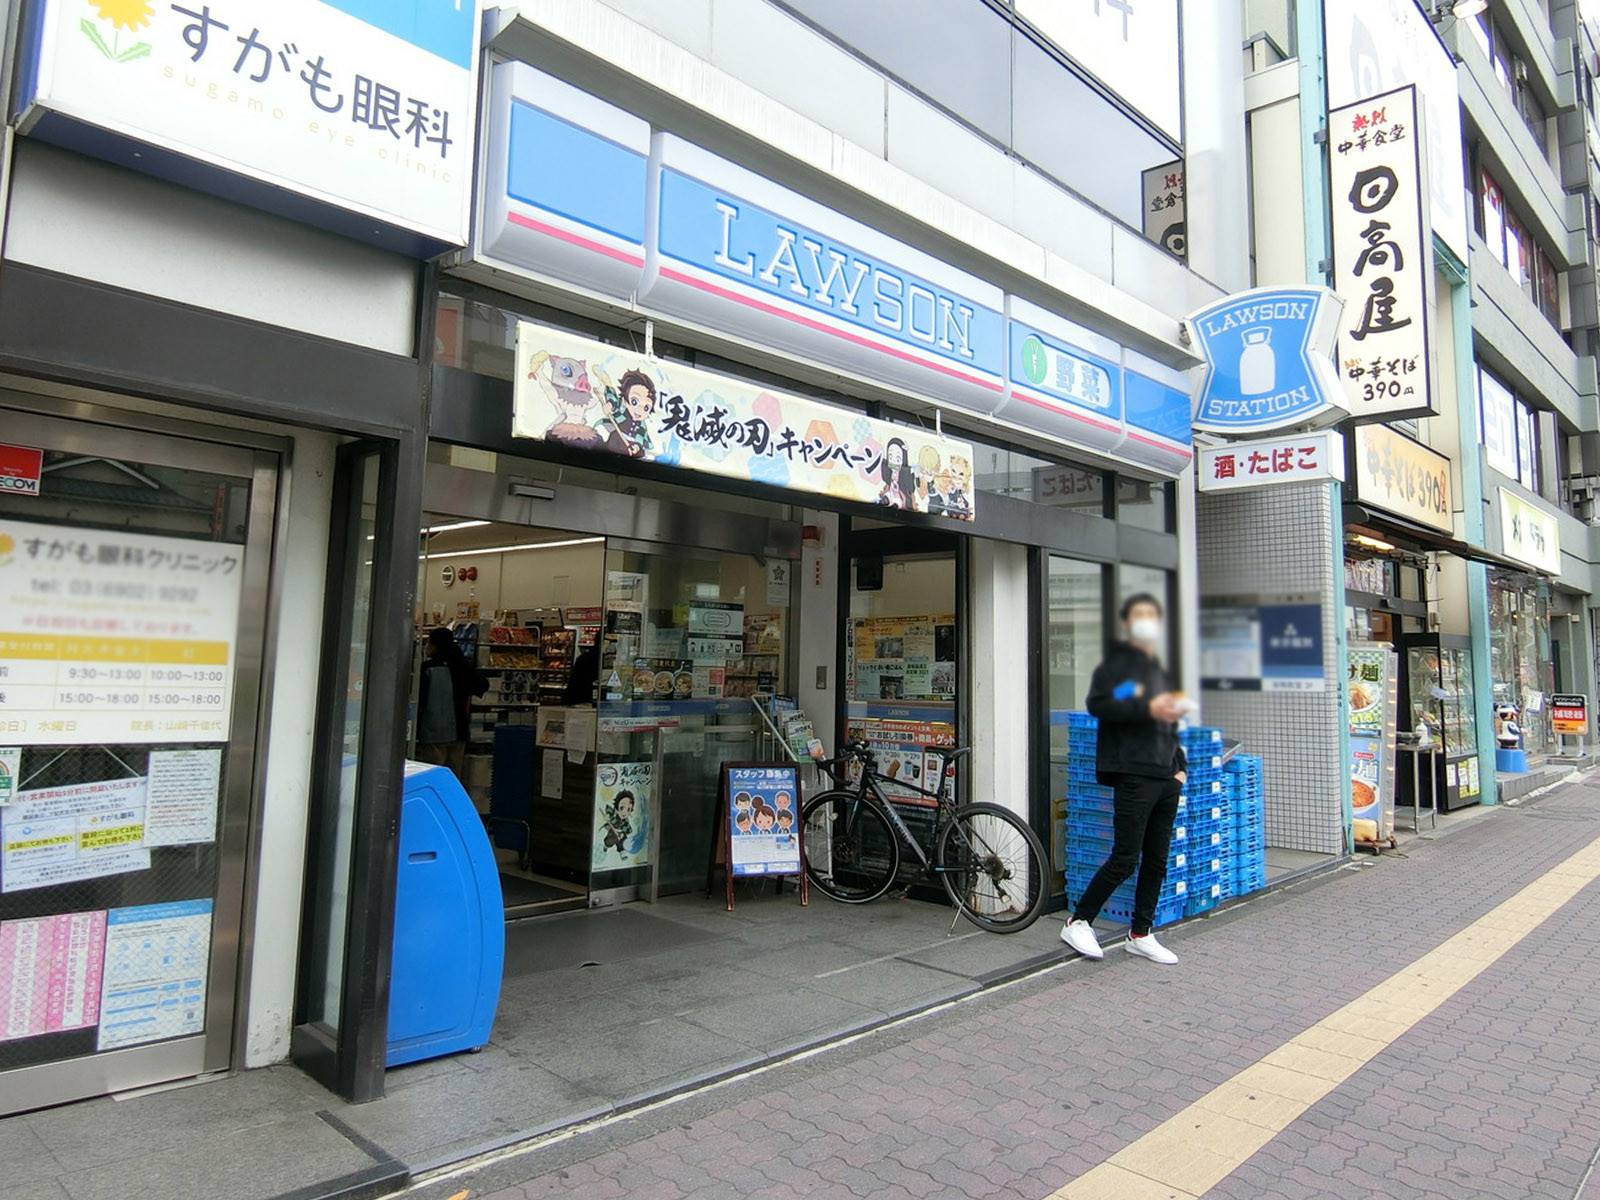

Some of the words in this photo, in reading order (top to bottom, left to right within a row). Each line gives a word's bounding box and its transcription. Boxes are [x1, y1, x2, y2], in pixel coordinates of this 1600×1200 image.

[170, 4, 453, 159] すがも眼科
[163, 63, 285, 121] sugamo
[308, 120, 356, 149] eye
[378, 146, 454, 184] clinic
[1337, 124, 1406, 156] 中華食堂
[1348, 165, 1412, 341] 日高屋
[714, 198, 975, 360] LAWSON
[1205, 302, 1309, 337] LAWSON
[1055, 356, 1103, 404] 野菜
[1348, 355, 1419, 382] 中華そば
[1208, 385, 1311, 418] STATION
[1214, 446, 1317, 480] 酒・たばこ
[23, 537, 238, 577] すがも眼科クリニック
